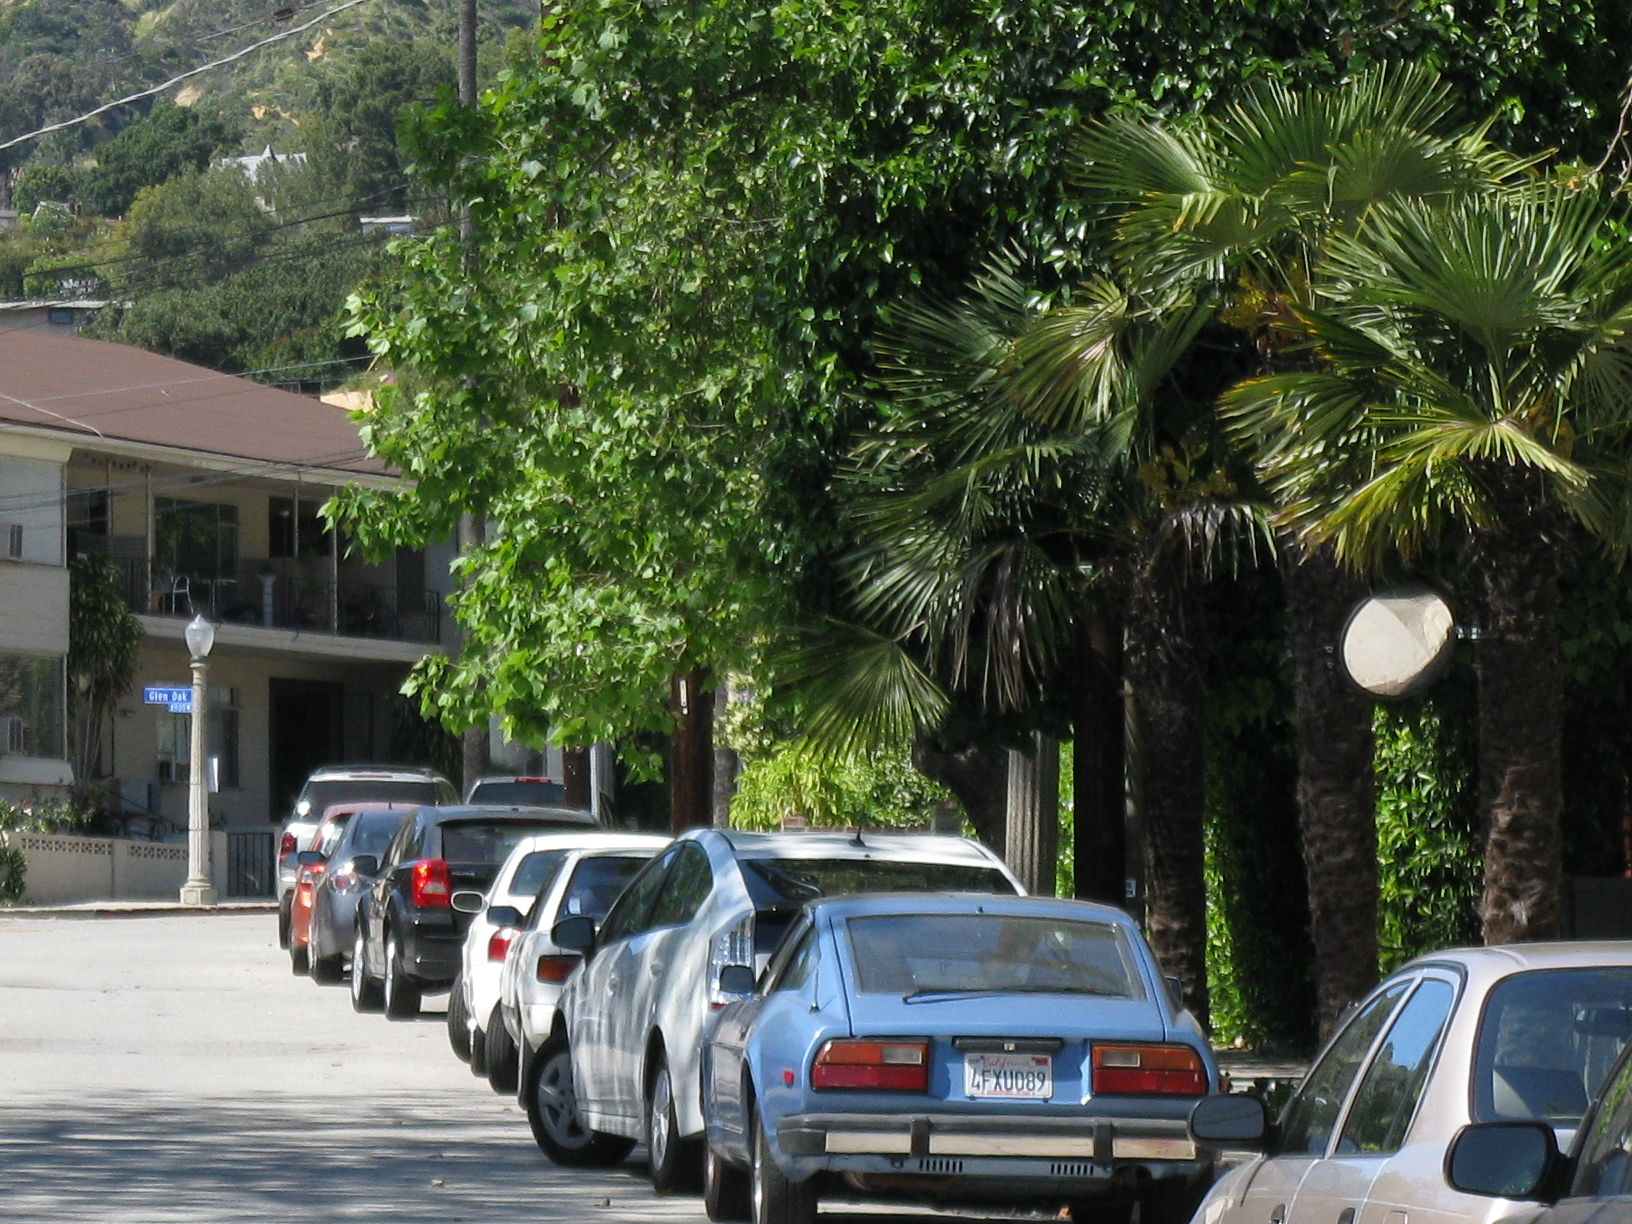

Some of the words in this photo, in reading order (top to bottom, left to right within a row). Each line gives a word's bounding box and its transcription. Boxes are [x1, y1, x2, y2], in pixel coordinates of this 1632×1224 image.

[149, 691, 168, 701] Glen
[172, 691, 187, 701] Oak
[971, 1068, 1046, 1092] 4FXU089
